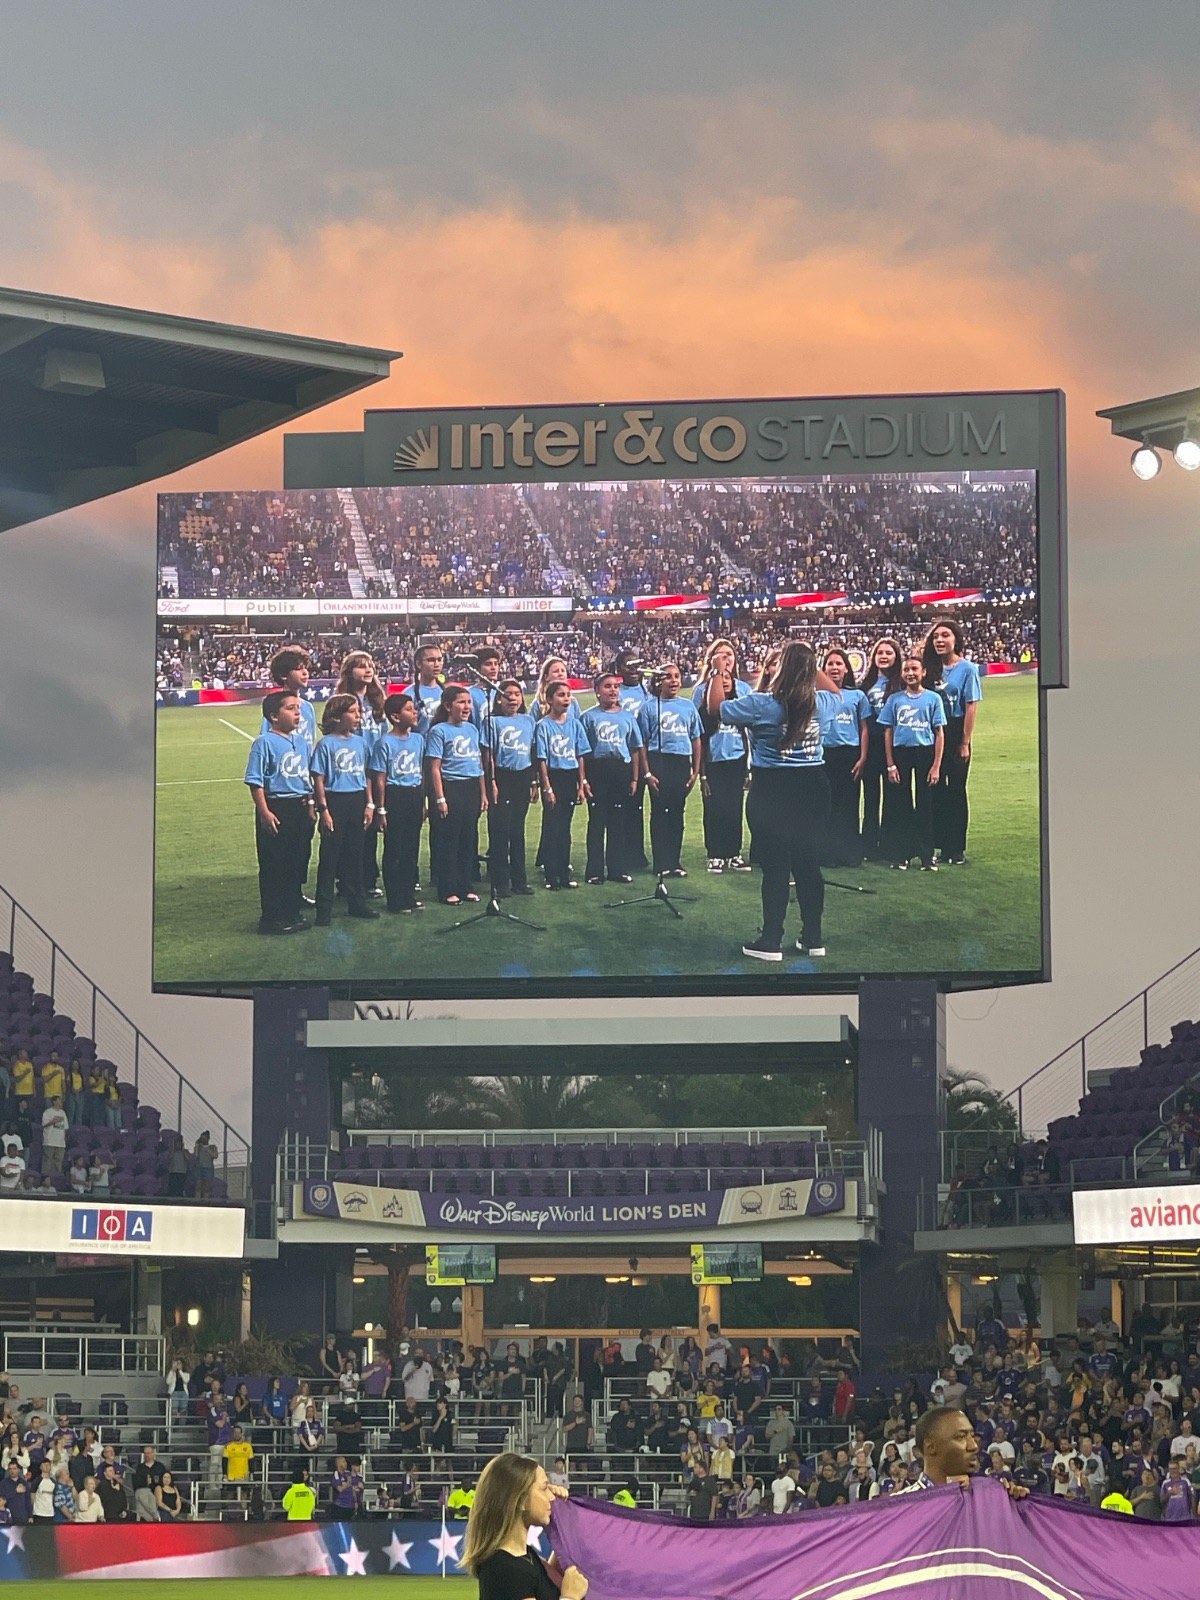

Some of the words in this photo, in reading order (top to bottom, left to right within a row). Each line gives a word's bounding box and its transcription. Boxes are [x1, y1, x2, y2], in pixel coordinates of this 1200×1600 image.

[755, 411, 1008, 461] STADIUM
[159, 600, 190, 613] Ford
[246, 602, 296, 613] Publix
[549, 1205, 595, 1222] World
[602, 1206, 662, 1222] LION'S
[668, 1202, 707, 1219] DEN
